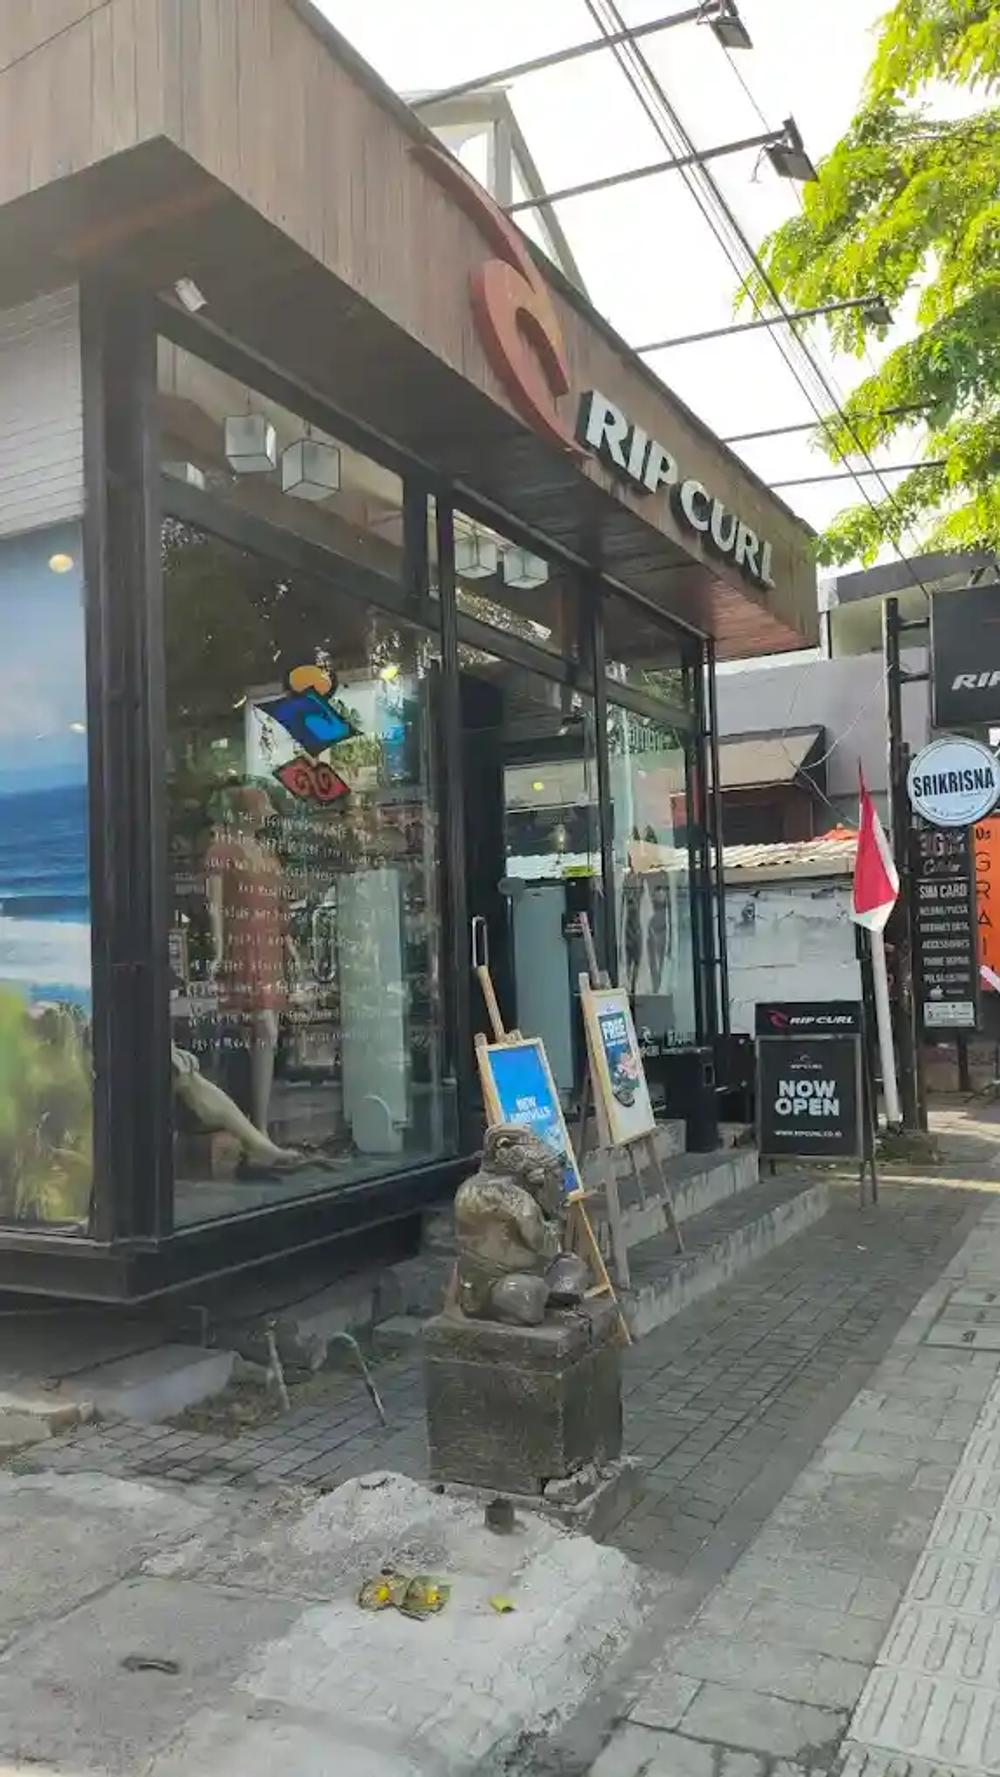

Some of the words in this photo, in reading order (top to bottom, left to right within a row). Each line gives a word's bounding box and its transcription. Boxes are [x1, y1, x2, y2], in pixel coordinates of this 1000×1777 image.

[582, 389, 679, 494] RIP
[675, 479, 776, 588] CURL
[912, 767, 995, 797] SRIKRISNA
[920, 884, 938, 899] SIM
[940, 883, 968, 898] CARD
[789, 1016, 814, 1025] RIP
[815, 1015, 855, 1024] CURL
[779, 1080, 835, 1098] NOW
[775, 1098, 840, 1116] OPEN
